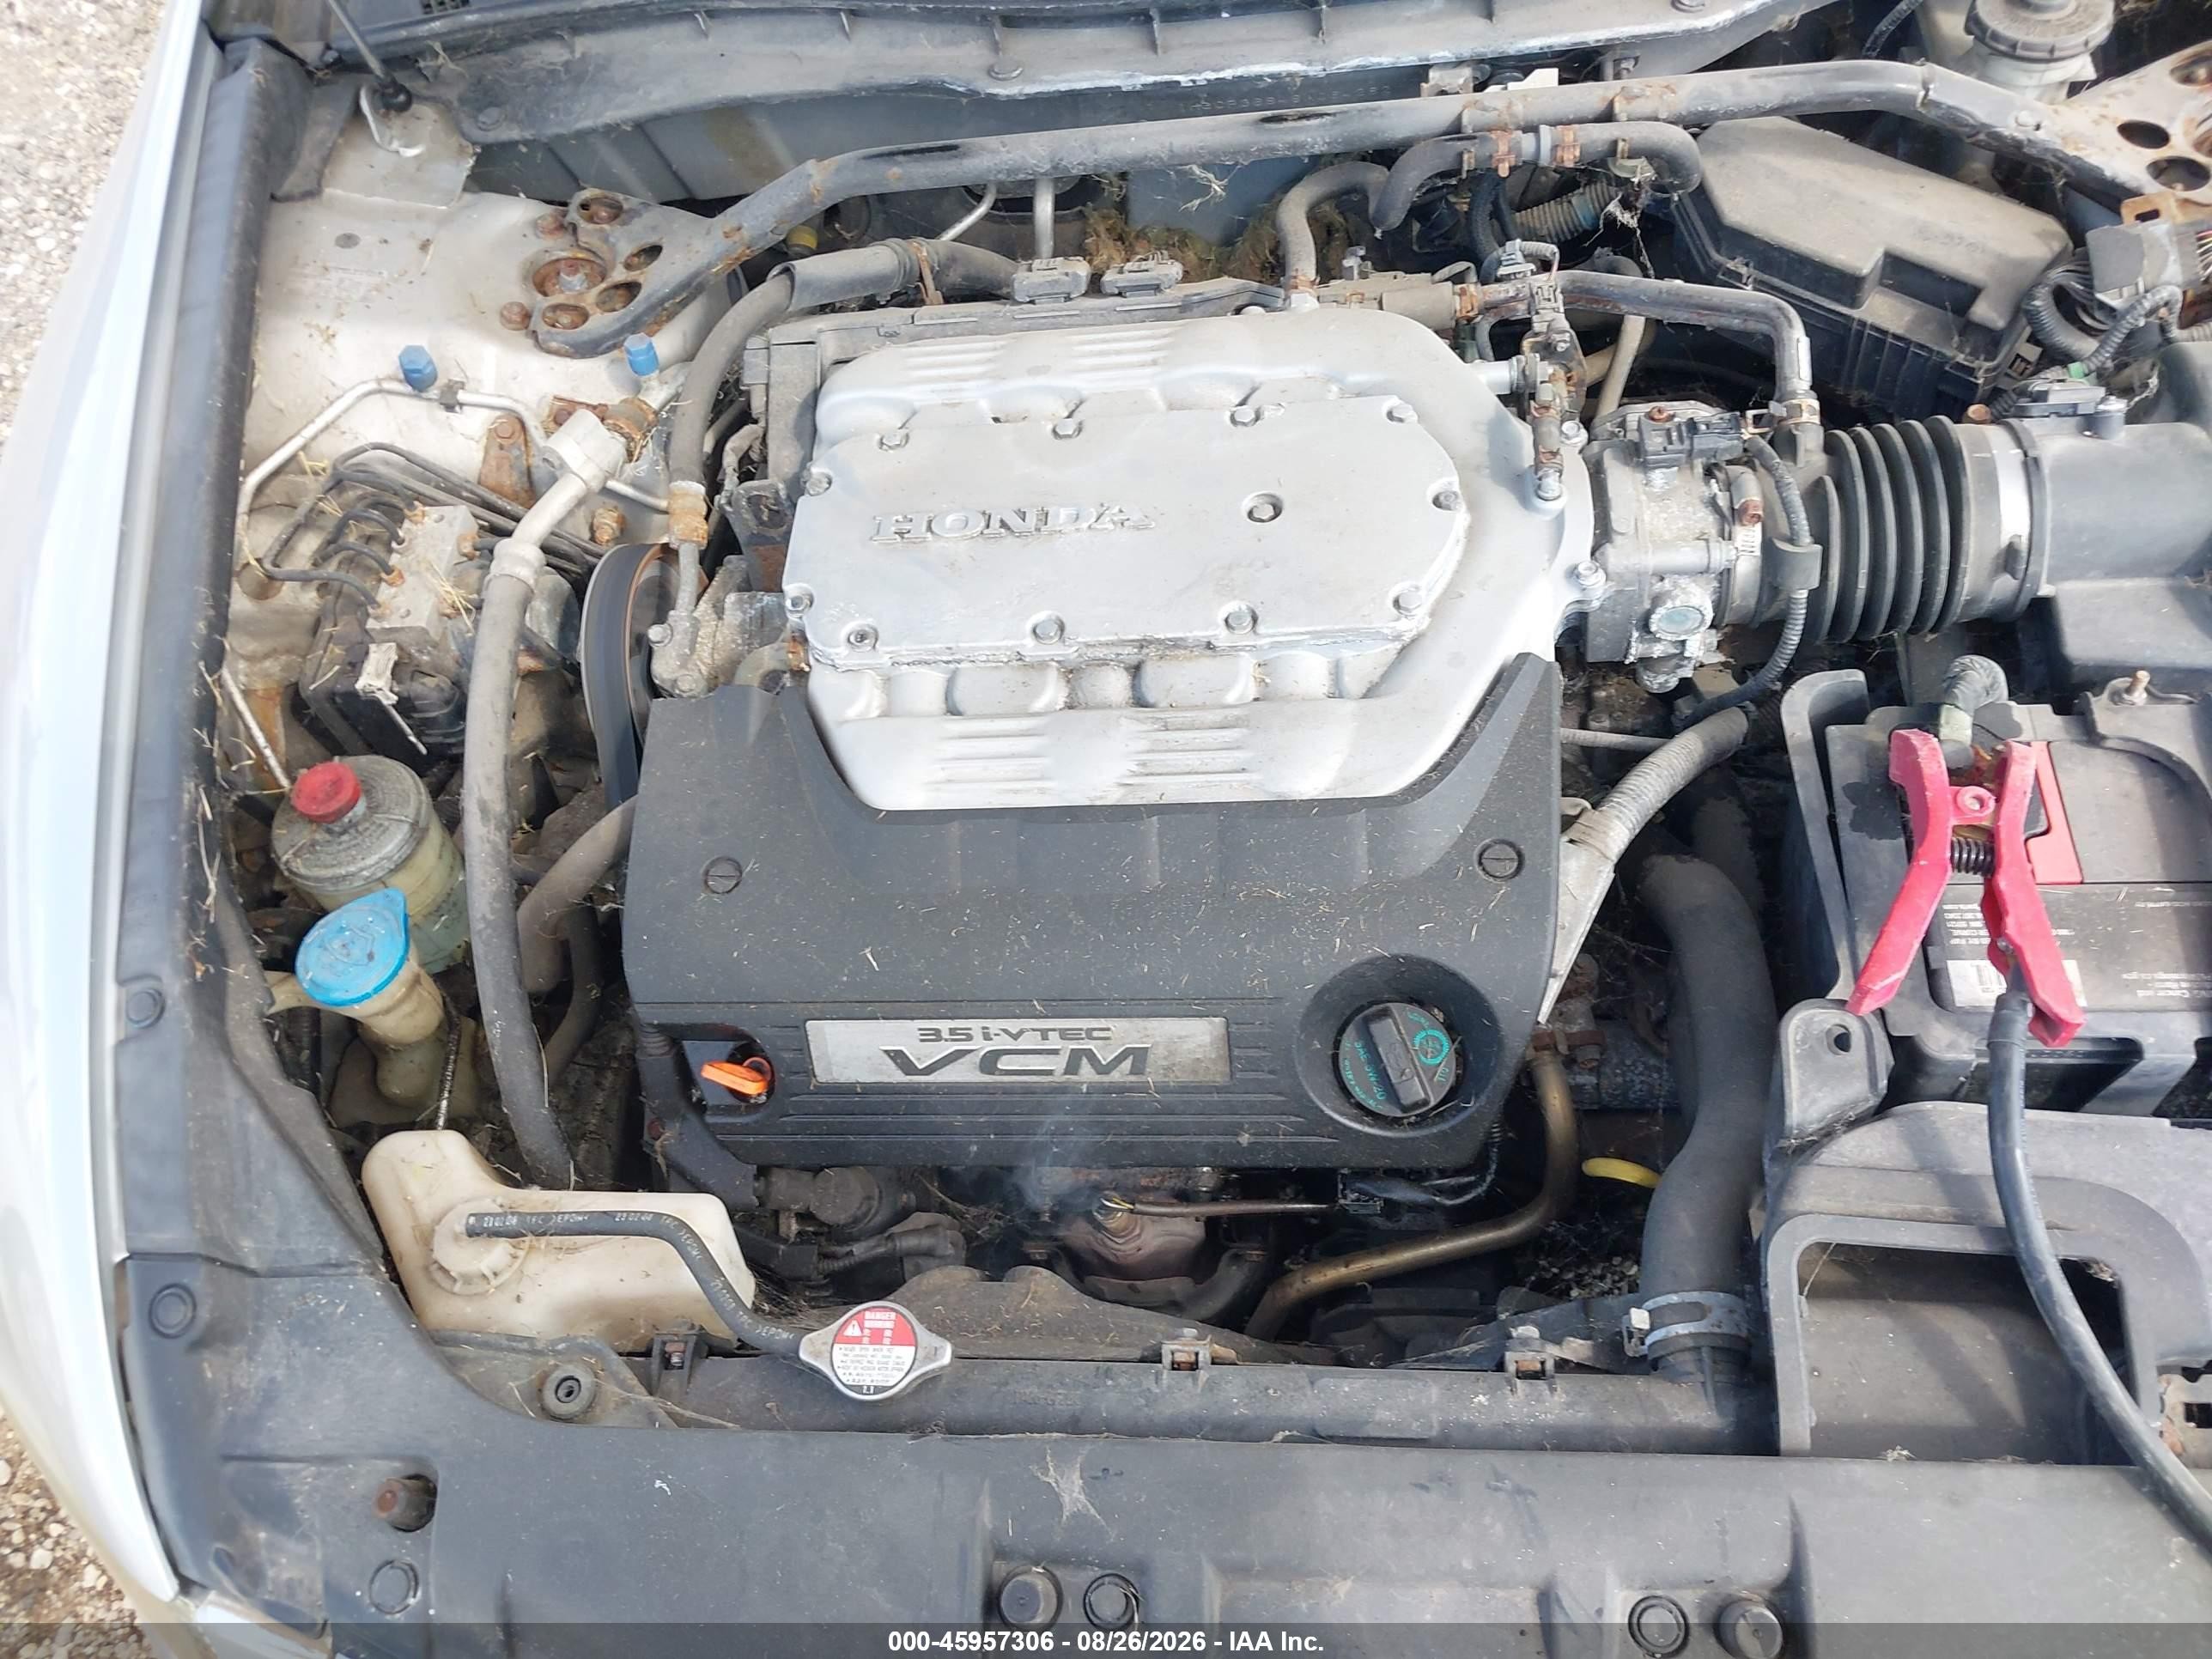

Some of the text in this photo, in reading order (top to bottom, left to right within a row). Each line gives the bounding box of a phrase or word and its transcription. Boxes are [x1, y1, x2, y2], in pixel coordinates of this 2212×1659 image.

[870, 504, 1155, 542] HONDA
[981, 1025, 1113, 1042] i-VTEC
[878, 1044, 1152, 1076] VCM
